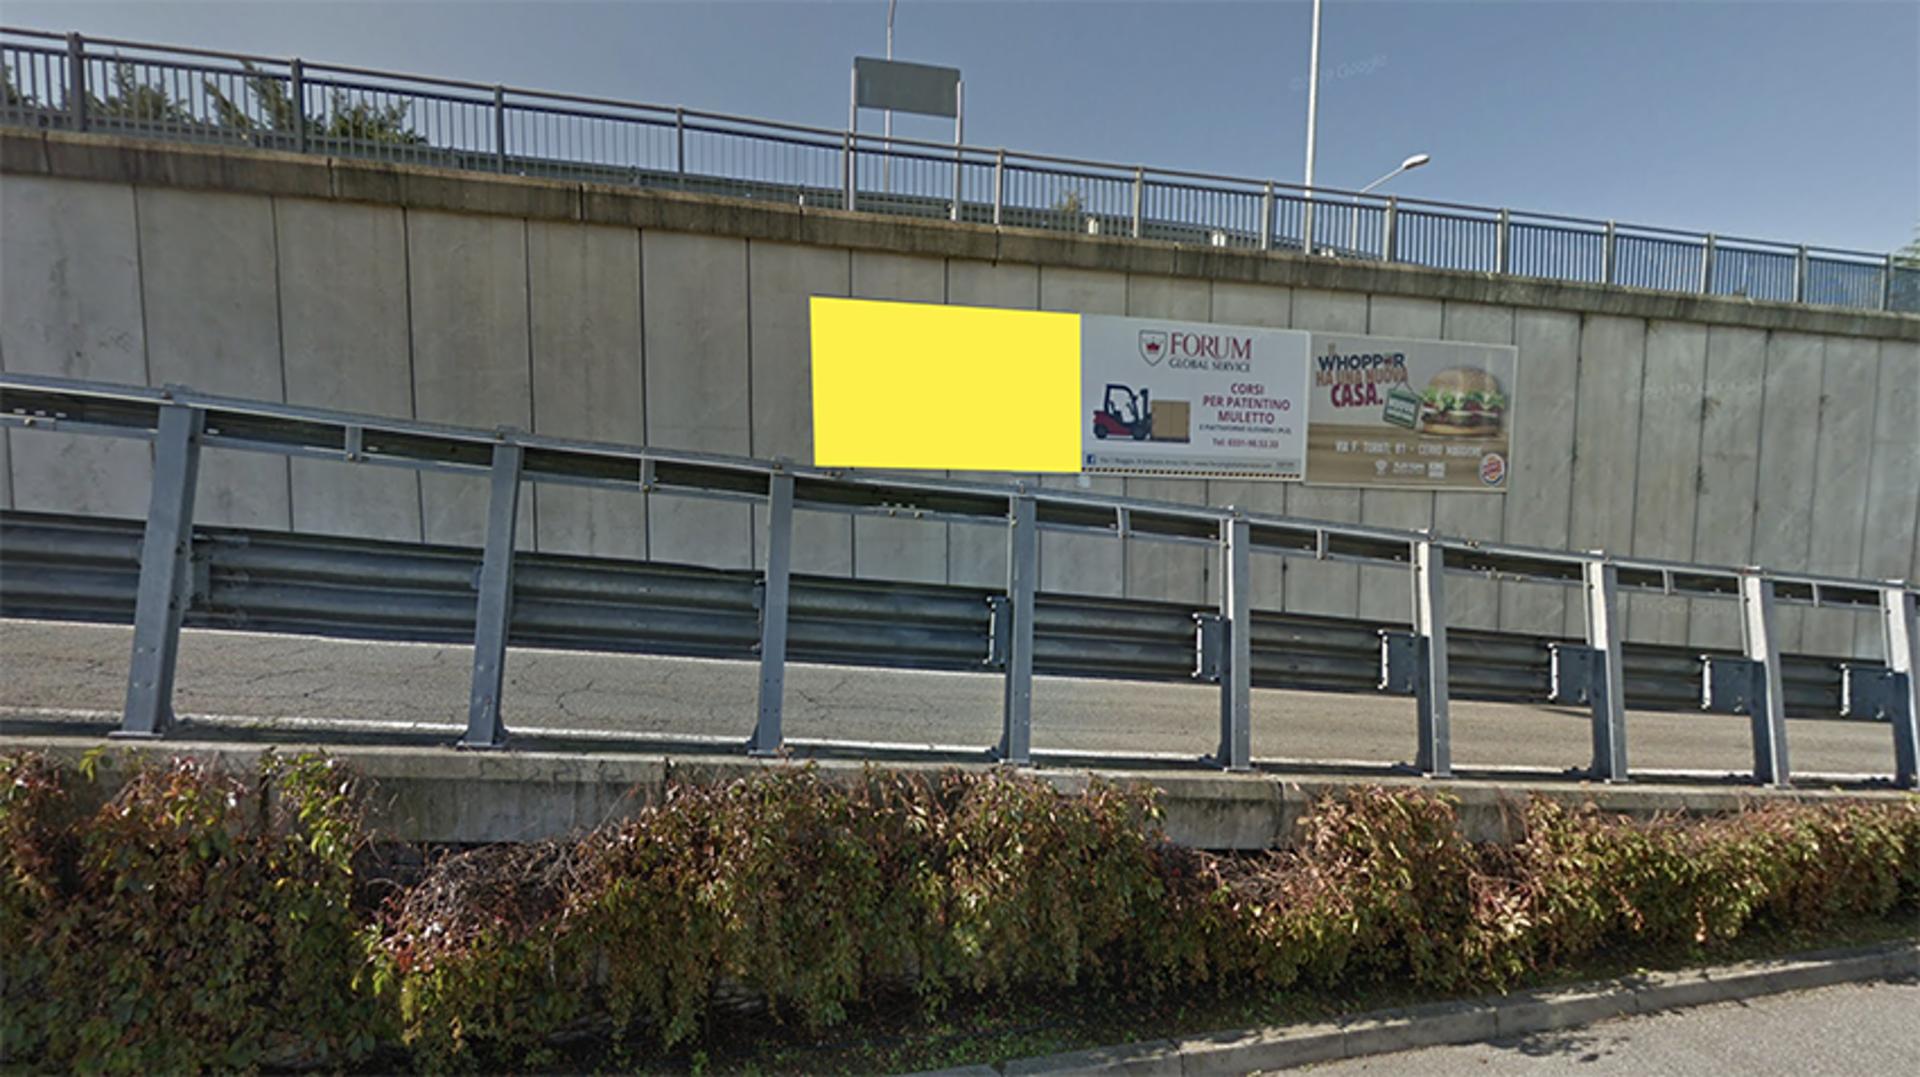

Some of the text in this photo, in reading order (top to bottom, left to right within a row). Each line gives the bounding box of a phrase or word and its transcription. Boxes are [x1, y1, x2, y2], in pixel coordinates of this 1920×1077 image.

[1170, 332, 1252, 360] FORUM
[1168, 358, 1251, 373] GLOBAL SERVICE
[1318, 353, 1406, 371] WHOPPR
[1315, 367, 1408, 387] HA UNA NUOVA
[1230, 383, 1265, 396] CORSI
[1330, 384, 1383, 408] CASA.
[1203, 395, 1291, 411] PER PATENTINO
[1217, 410, 1275, 424] MULETTO
